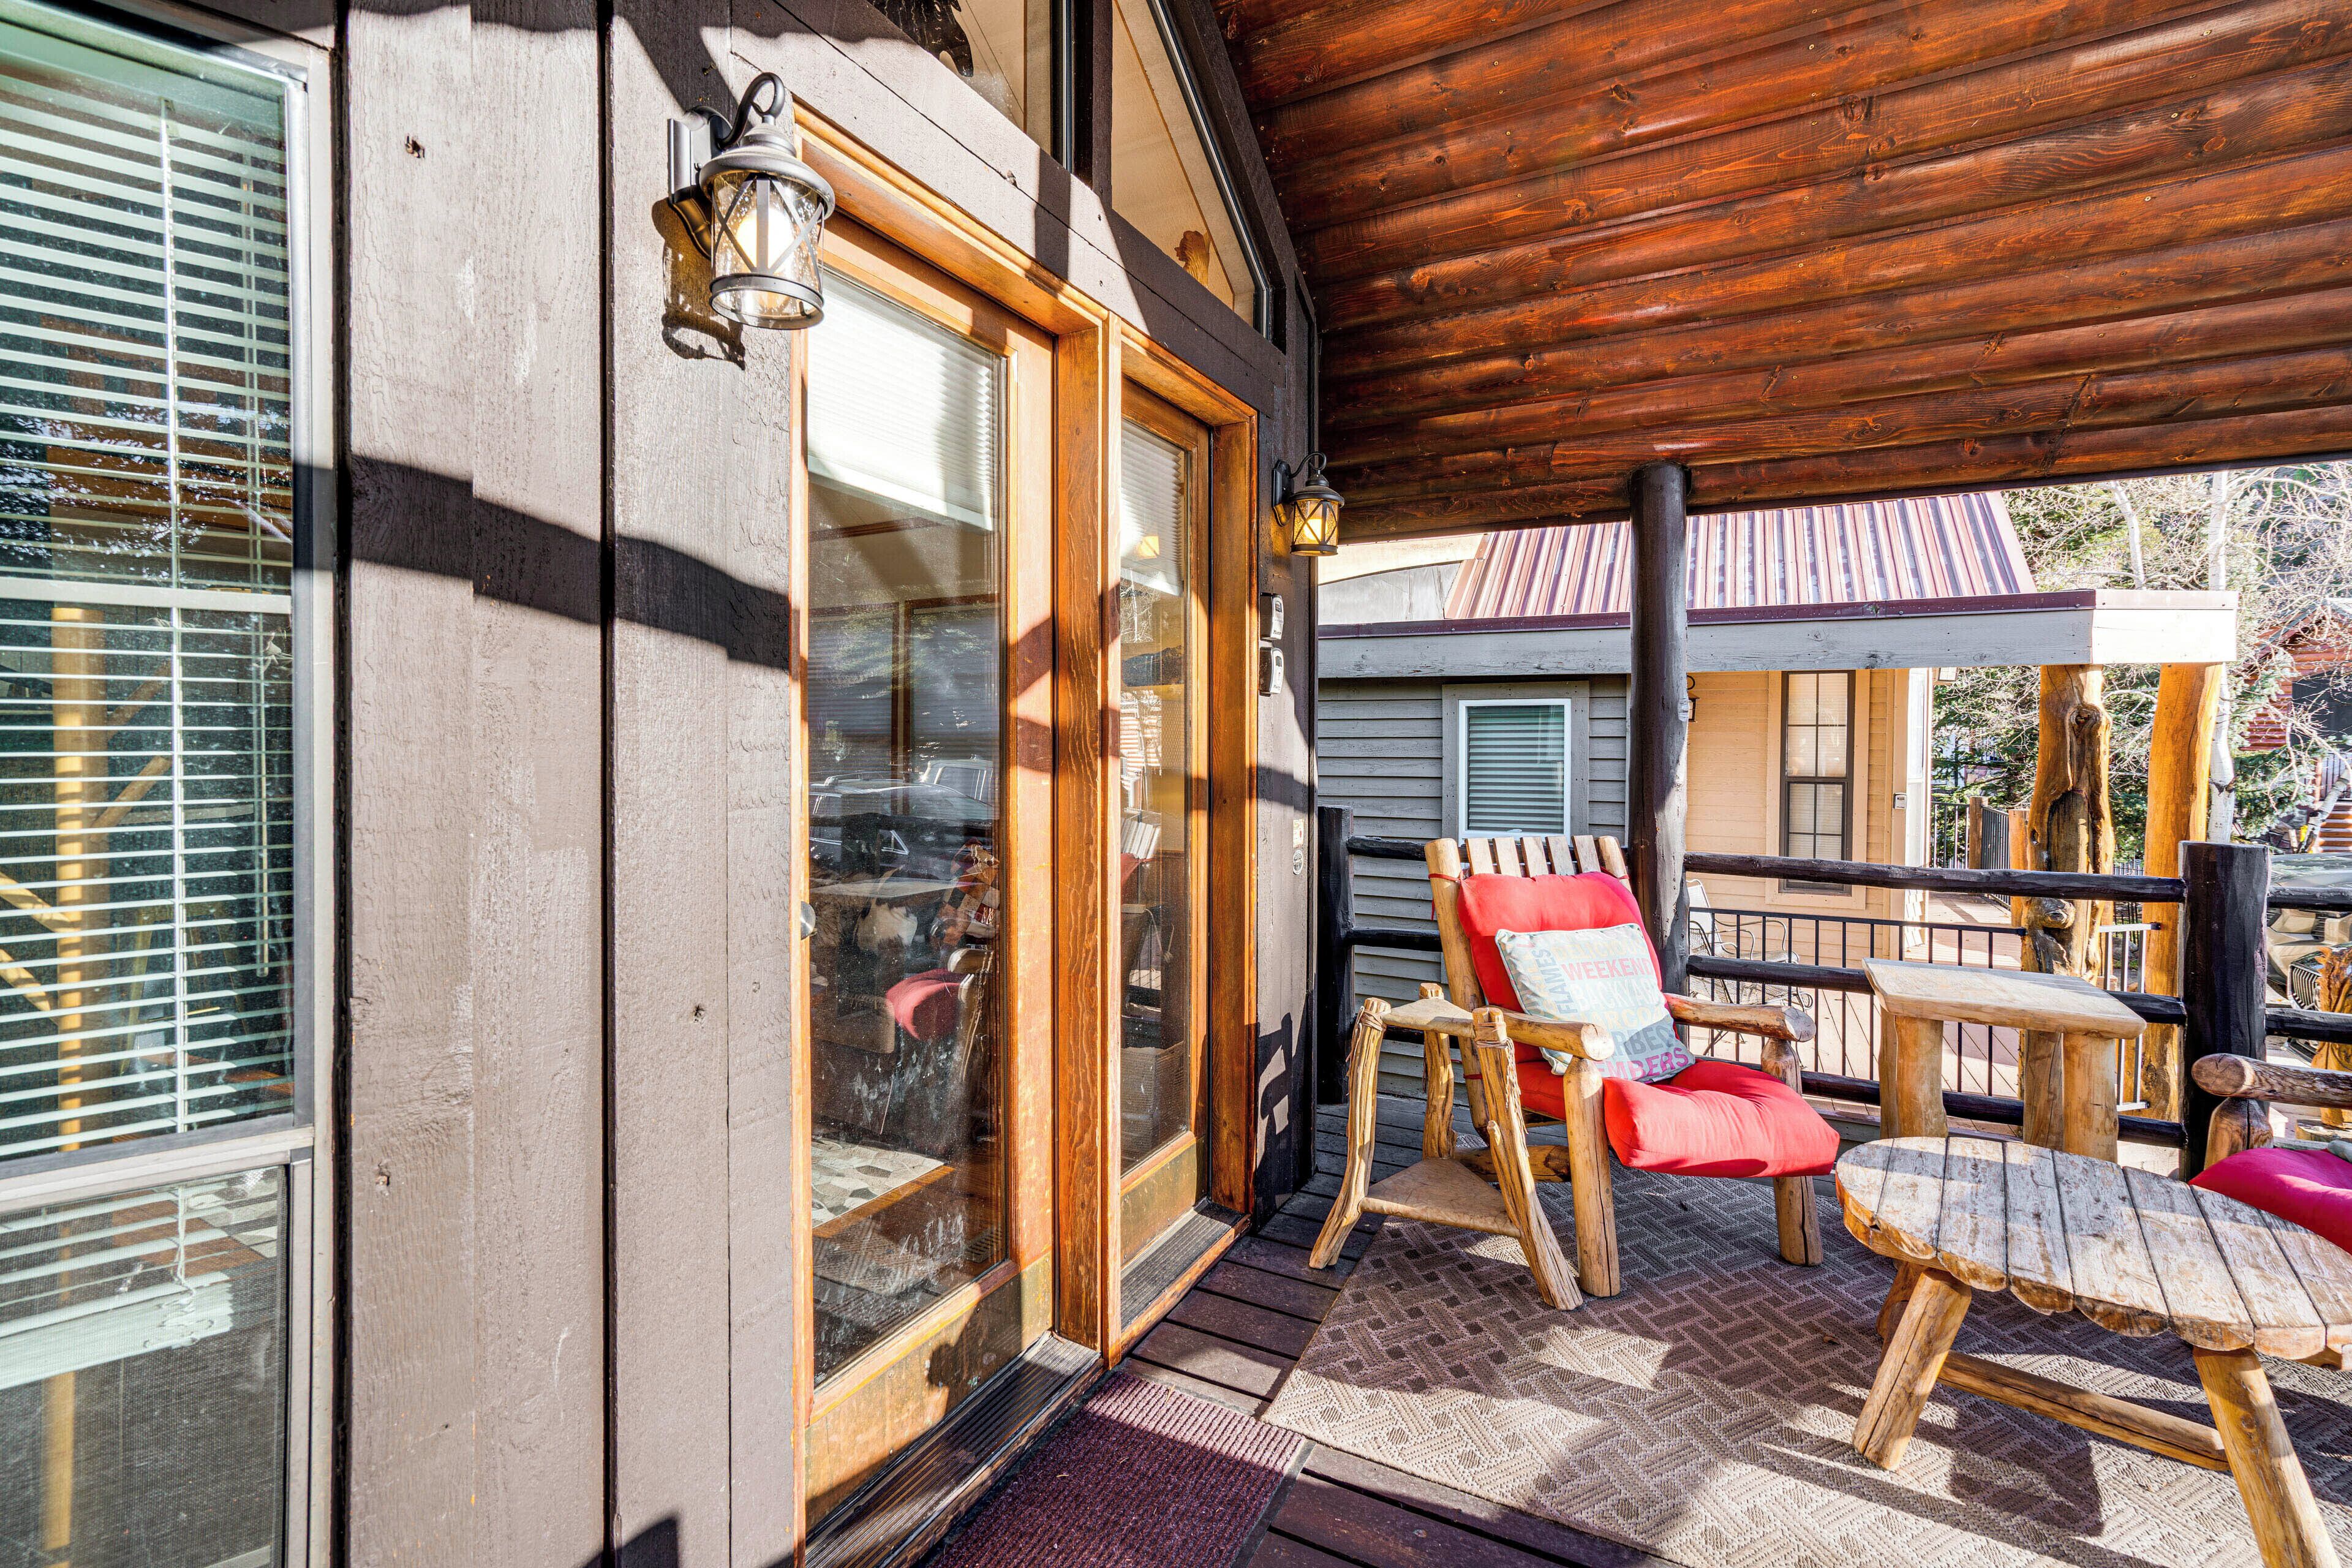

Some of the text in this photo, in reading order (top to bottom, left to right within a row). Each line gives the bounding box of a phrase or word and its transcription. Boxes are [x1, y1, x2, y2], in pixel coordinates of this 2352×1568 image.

[1552, 940, 1648, 960] DELICIOUS
[1531, 949, 1578, 1014] FLAMES
[1561, 957, 1655, 981] WEEKEND
[1586, 1002, 1661, 1030] ARCOA
